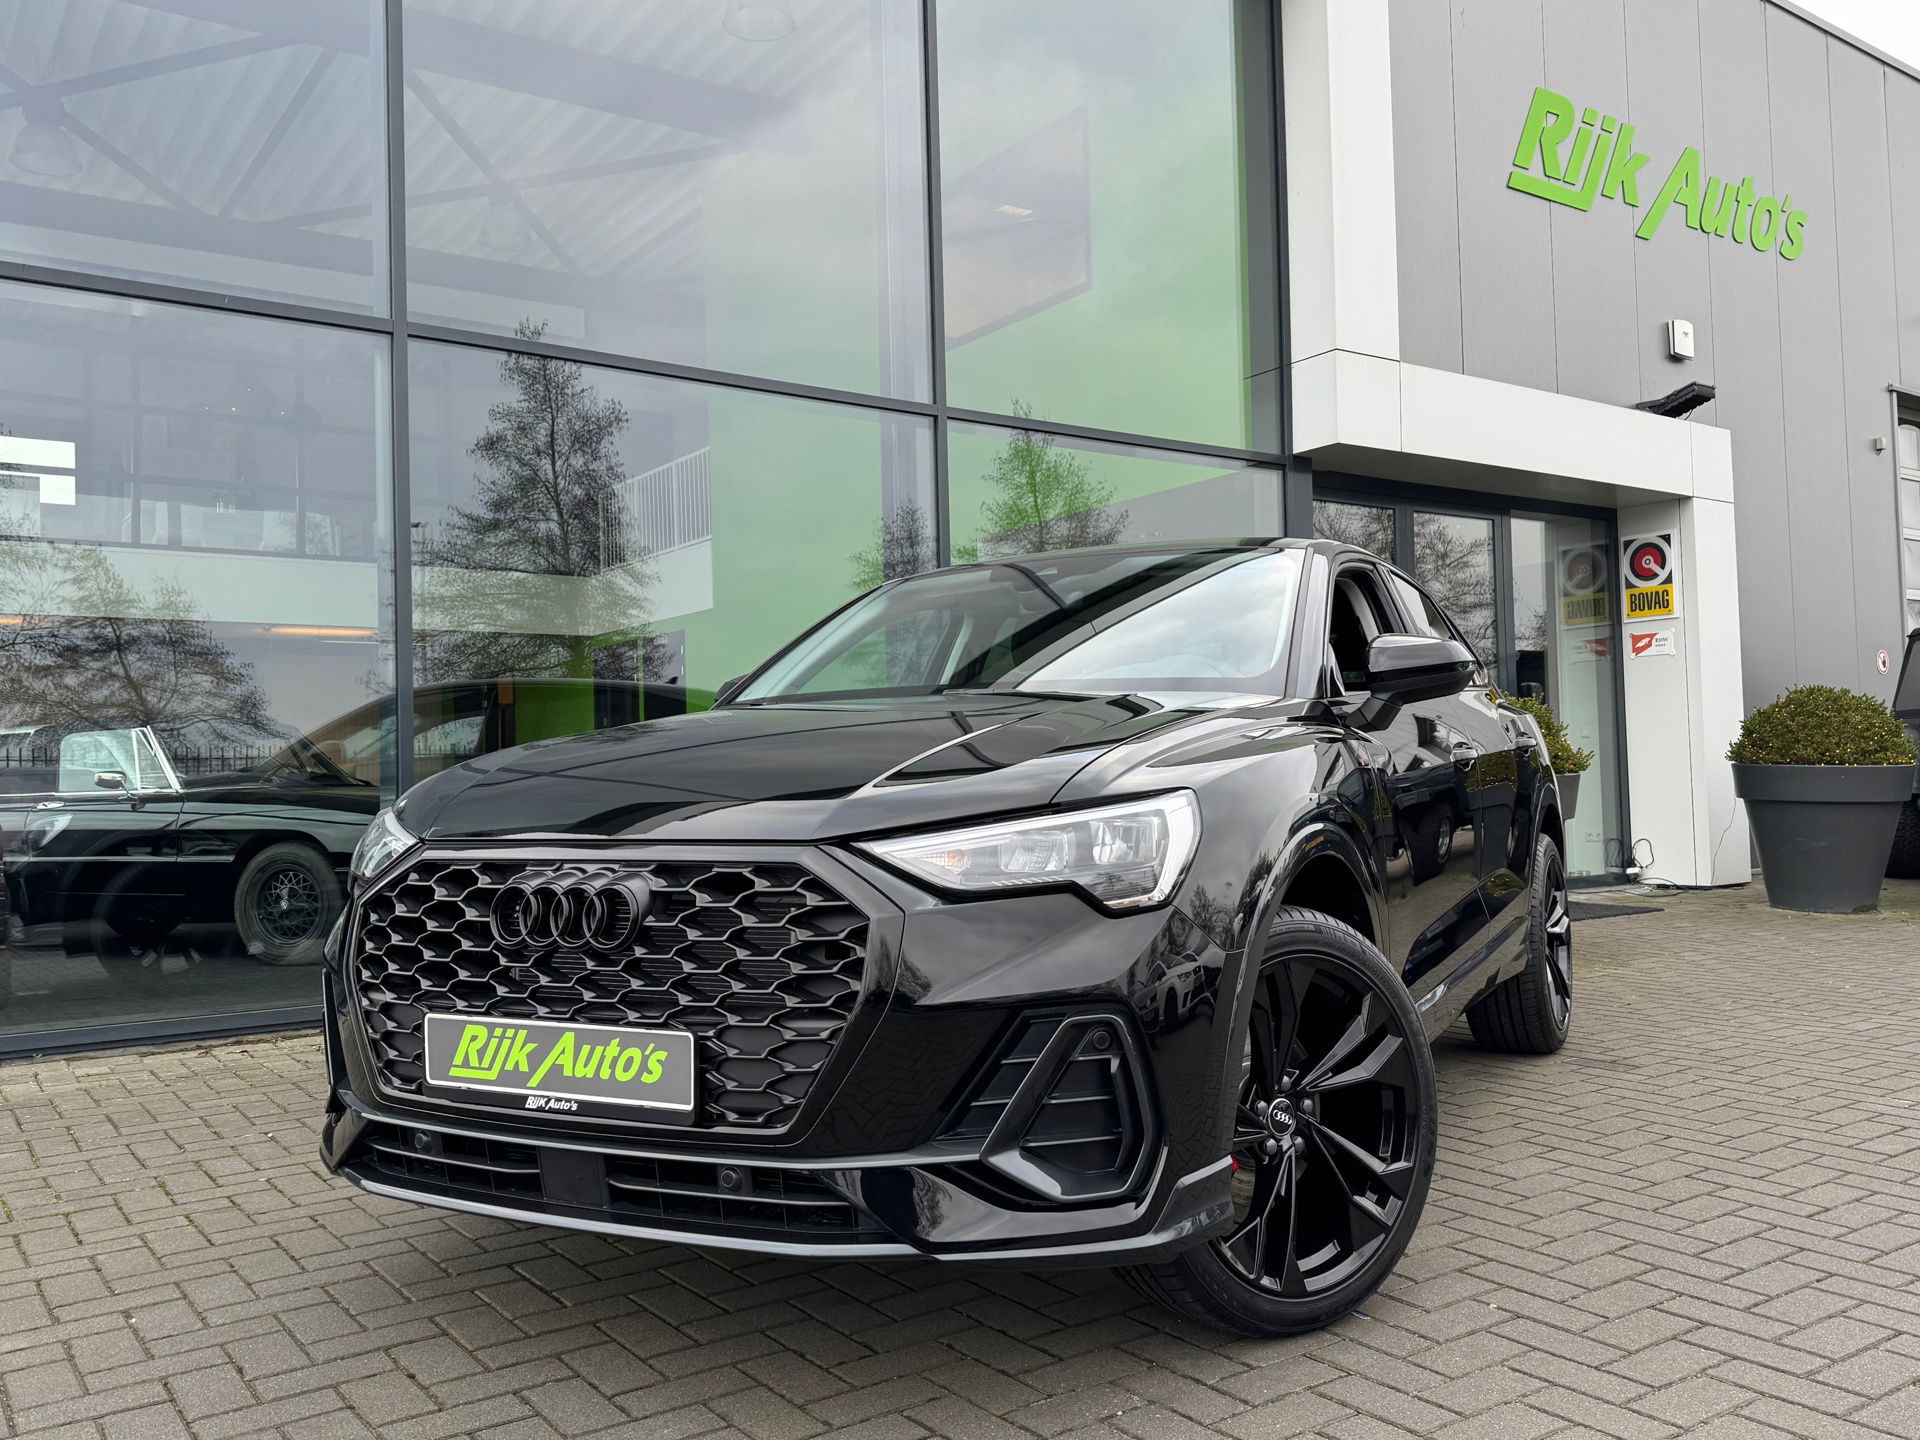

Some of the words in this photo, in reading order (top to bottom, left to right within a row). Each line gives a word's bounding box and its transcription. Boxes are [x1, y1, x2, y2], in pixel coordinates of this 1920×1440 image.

[1507, 86, 1651, 212] Rijk
[1635, 146, 1809, 261] Auto's
[1629, 589, 1670, 613] BOVAG
[448, 1024, 538, 1081] Rijk
[526, 1031, 668, 1088] Auto's
[545, 1098, 578, 1111] Auto's
